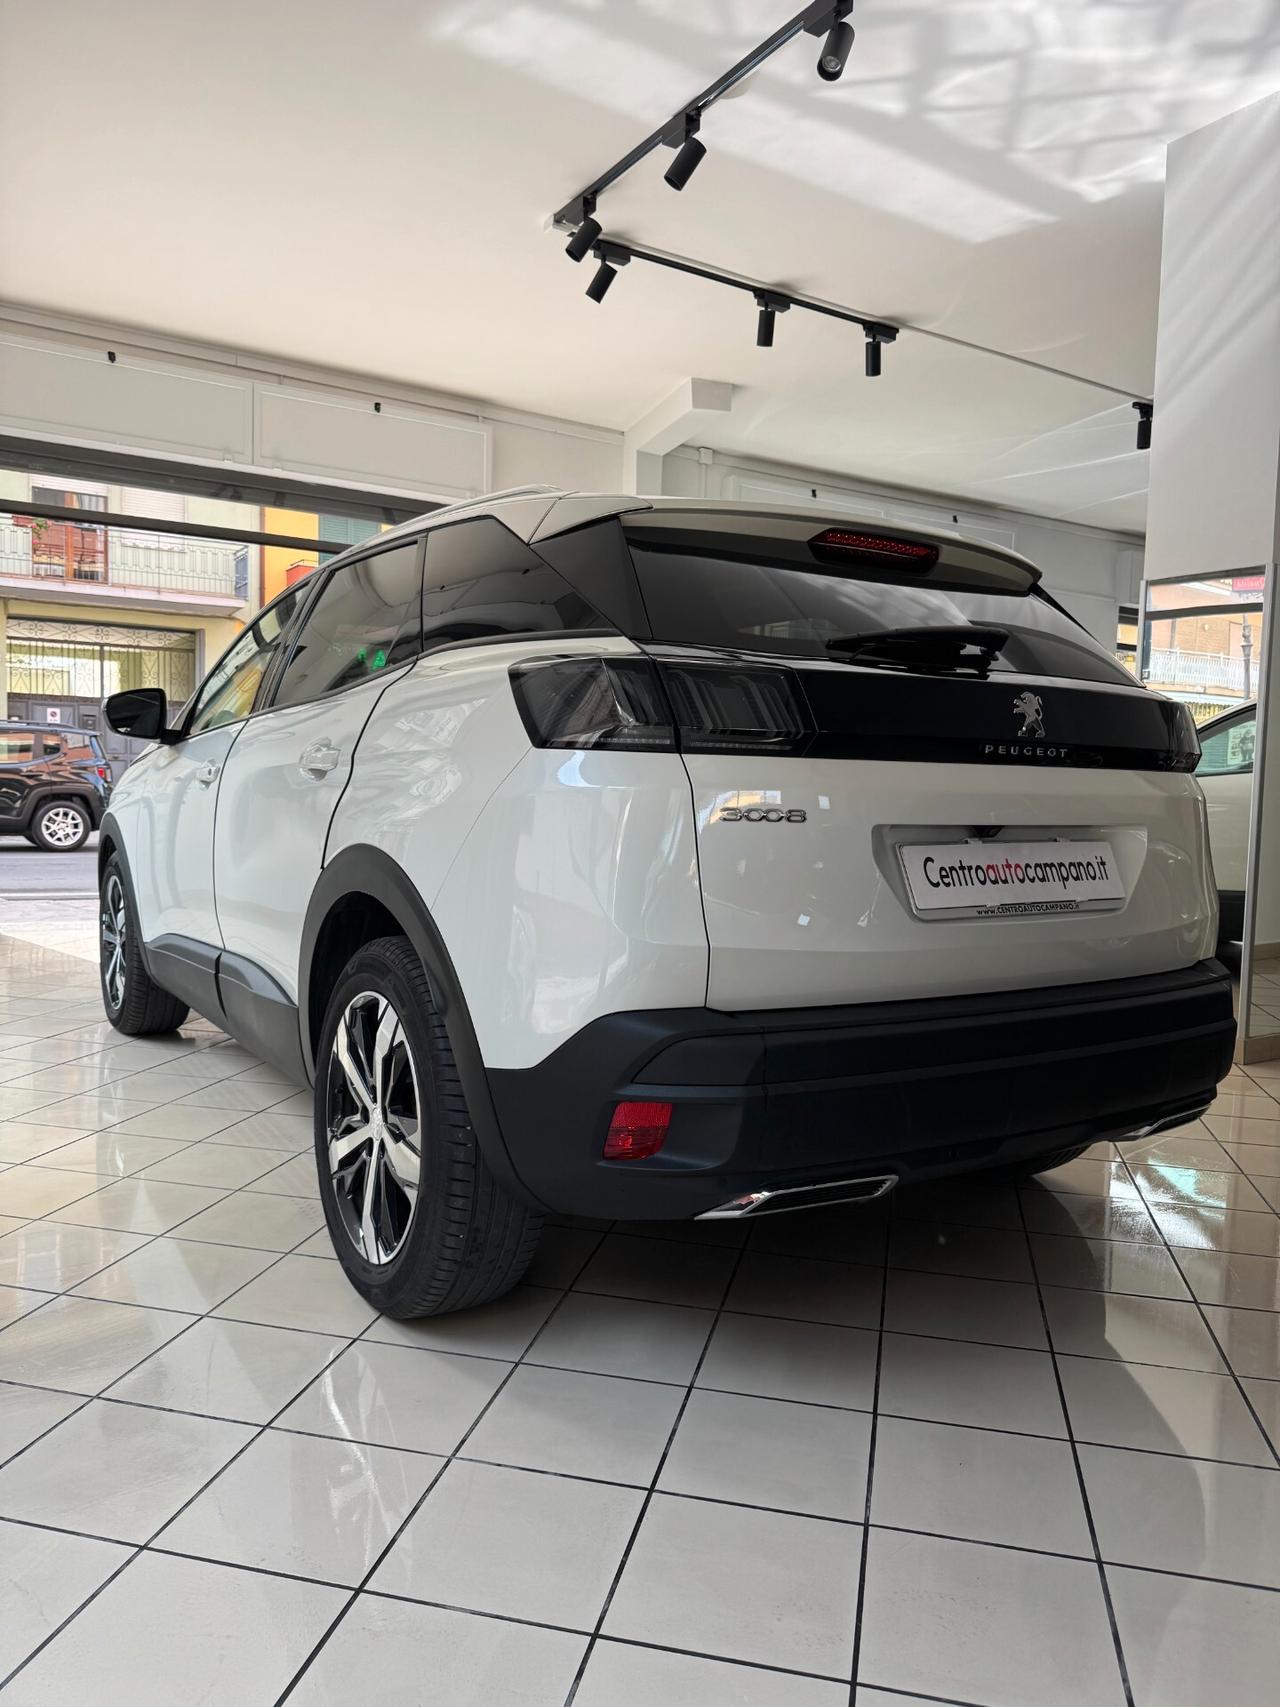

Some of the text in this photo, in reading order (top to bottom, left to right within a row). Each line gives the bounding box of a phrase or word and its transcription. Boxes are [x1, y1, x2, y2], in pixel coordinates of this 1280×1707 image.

[985, 744, 1068, 758] PEUGEOT
[719, 807, 807, 823] 3008
[923, 856, 1109, 889] Centroautocampano.it
